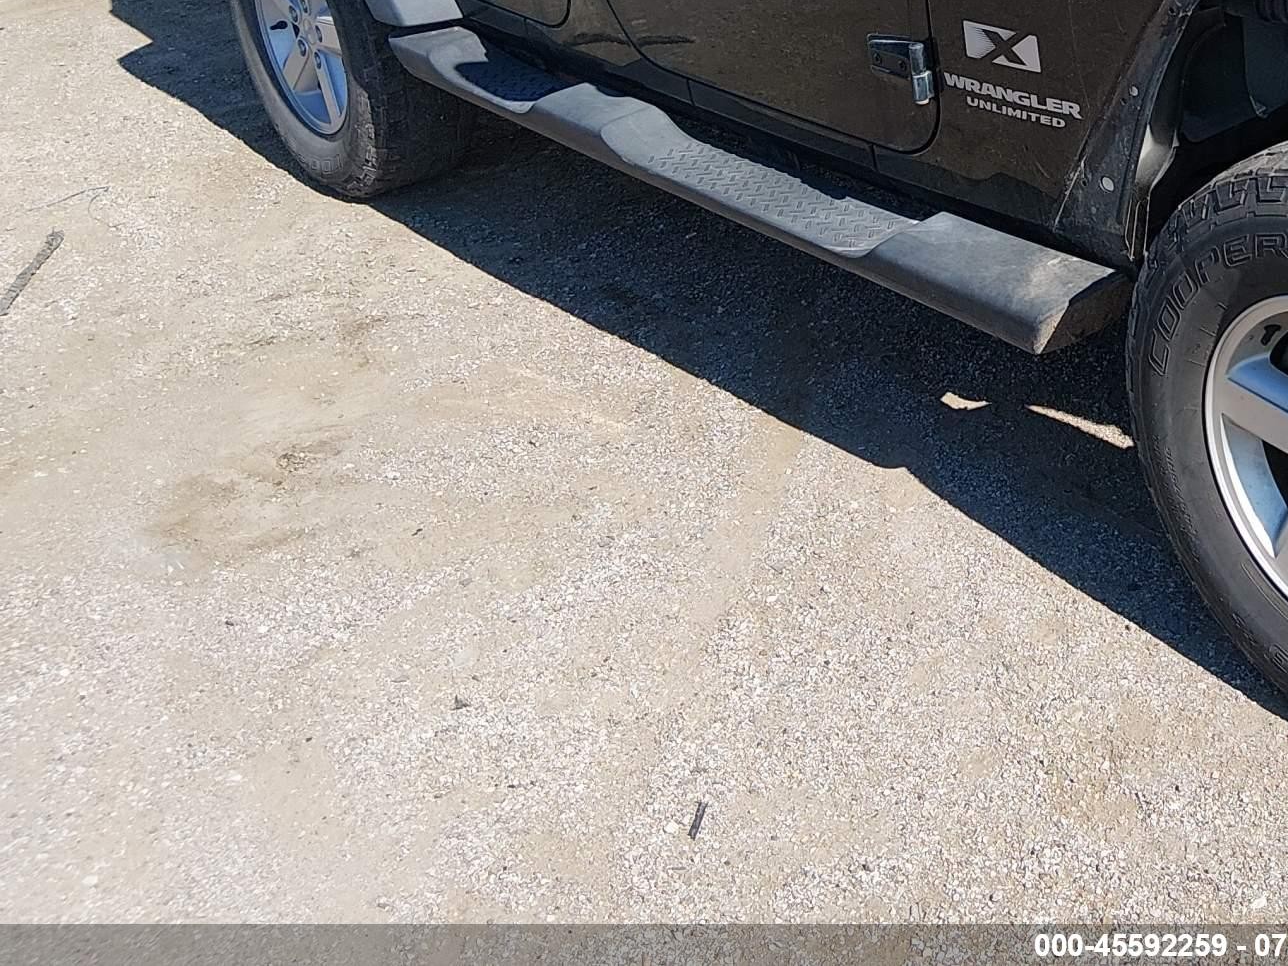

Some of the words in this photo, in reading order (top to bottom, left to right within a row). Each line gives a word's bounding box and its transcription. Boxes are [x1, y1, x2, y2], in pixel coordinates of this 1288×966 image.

[943, 71, 1084, 120] WRANGLER
[966, 95, 1067, 129] UNLIMITED
[1148, 232, 1288, 377] COOPER
